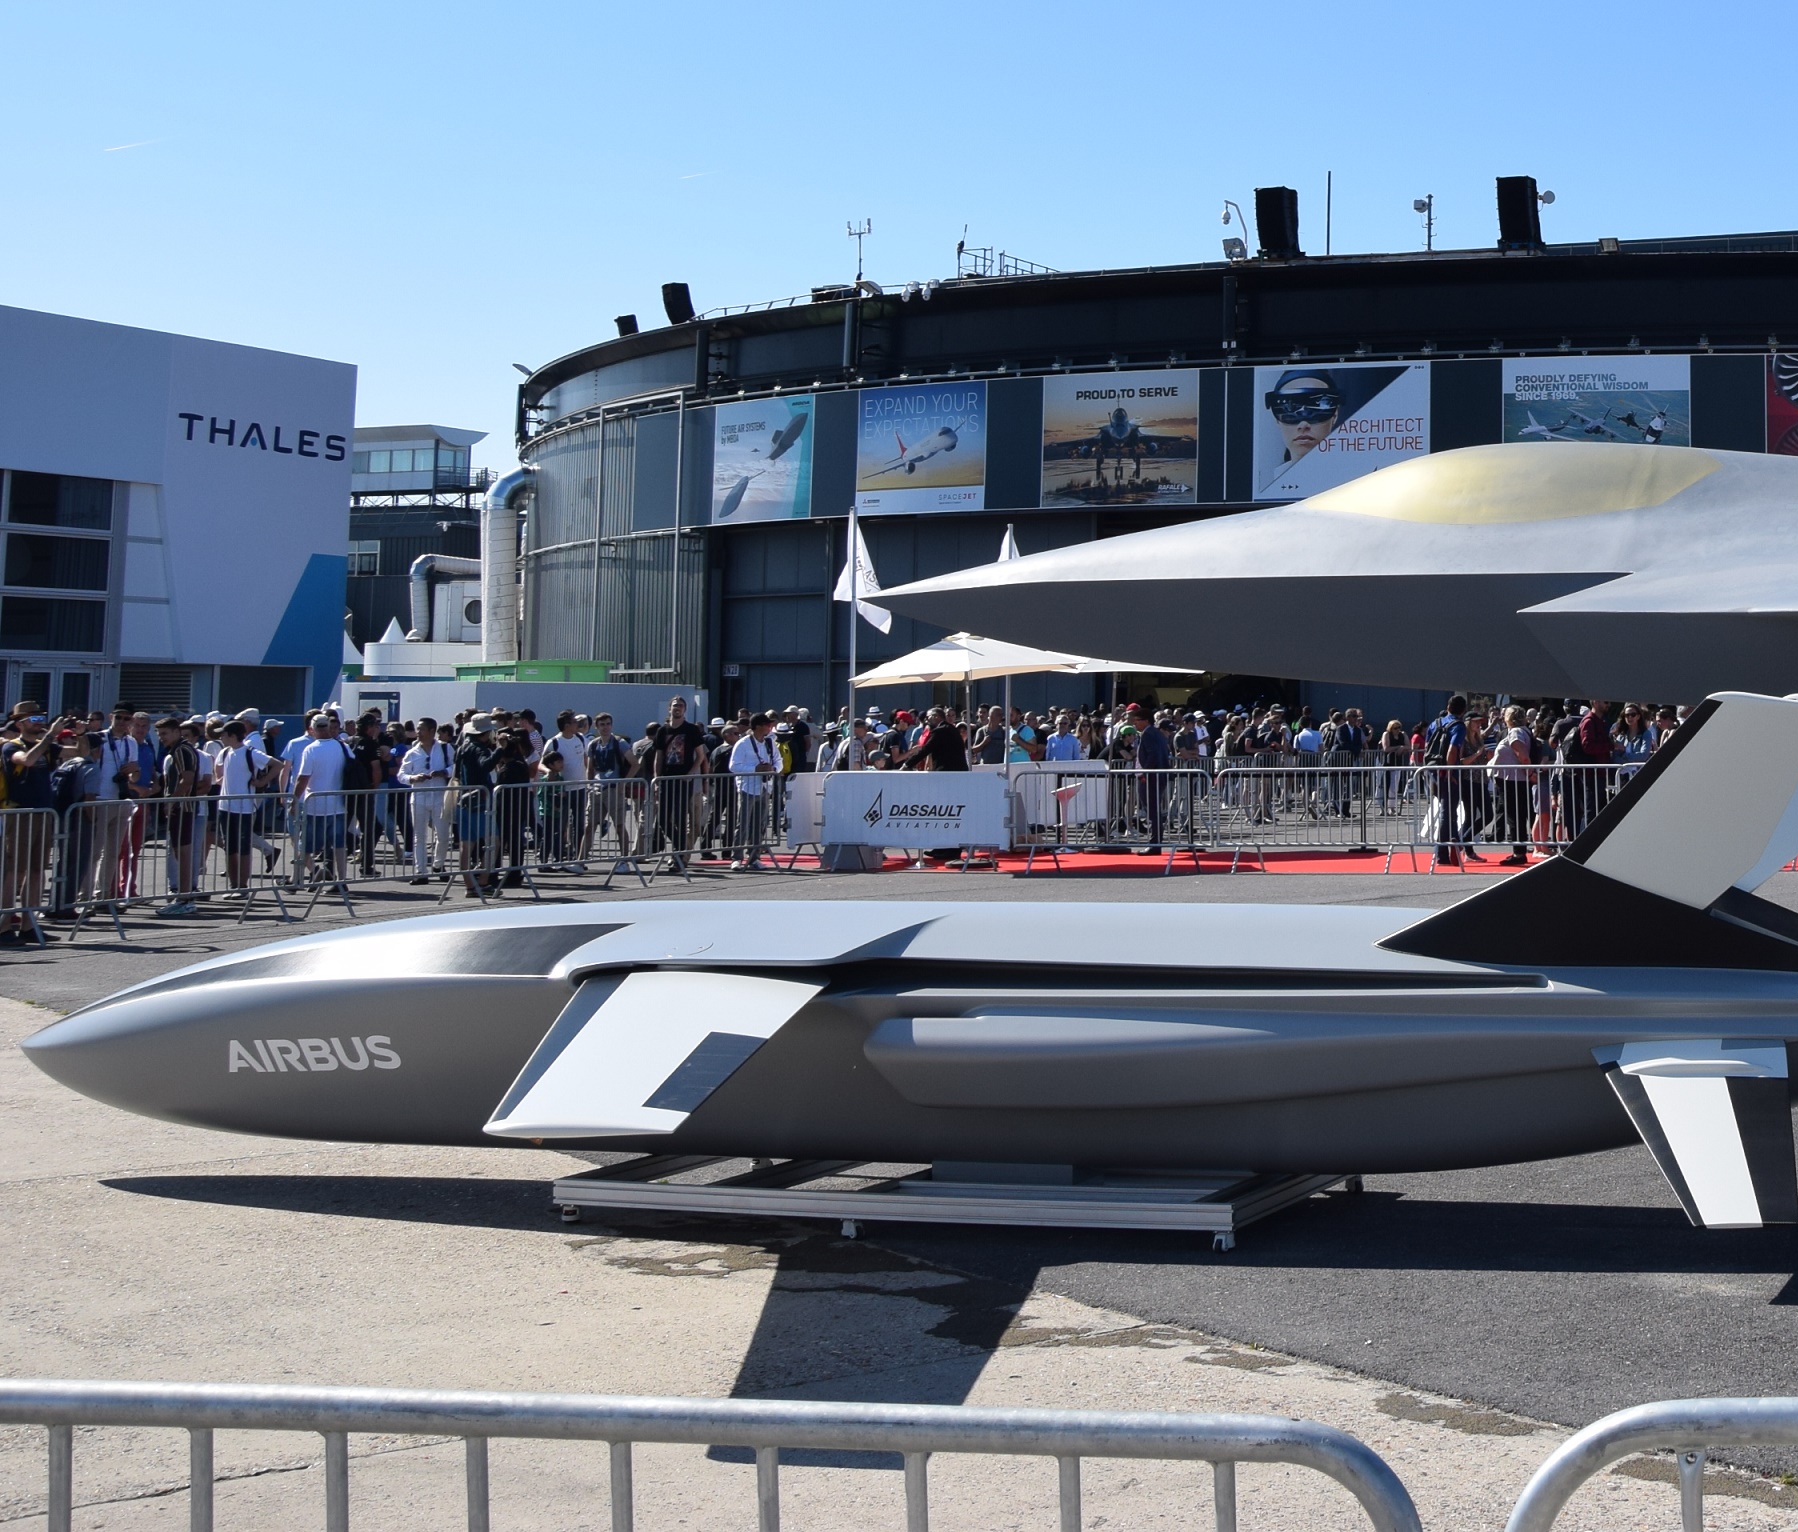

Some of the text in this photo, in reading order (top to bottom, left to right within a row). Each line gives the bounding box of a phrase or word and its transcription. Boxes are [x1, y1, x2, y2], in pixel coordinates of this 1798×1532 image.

[1515, 373, 1617, 383] PROUDLY DEFYING
[1076, 386, 1179, 400] PROUD TO SERVE
[1515, 381, 1649, 392] CONVENTIONAL WISDOM
[1515, 390, 1579, 401] SINCE 1969.
[865, 392, 978, 418] EXPAND YOUR
[721, 424, 737, 435] FUTURE
[746, 421, 767, 432] SYSTEMS
[864, 414, 979, 440] EXPECTATIONS
[1338, 418, 1424, 434] ARCHITECT
[178, 412, 346, 462] THALES
[1319, 436, 1424, 453] OF THE FUTURE
[939, 492, 977, 501] SPACEJET
[889, 804, 966, 817] DASSAULT
[229, 1035, 402, 1073] AIRBUS
